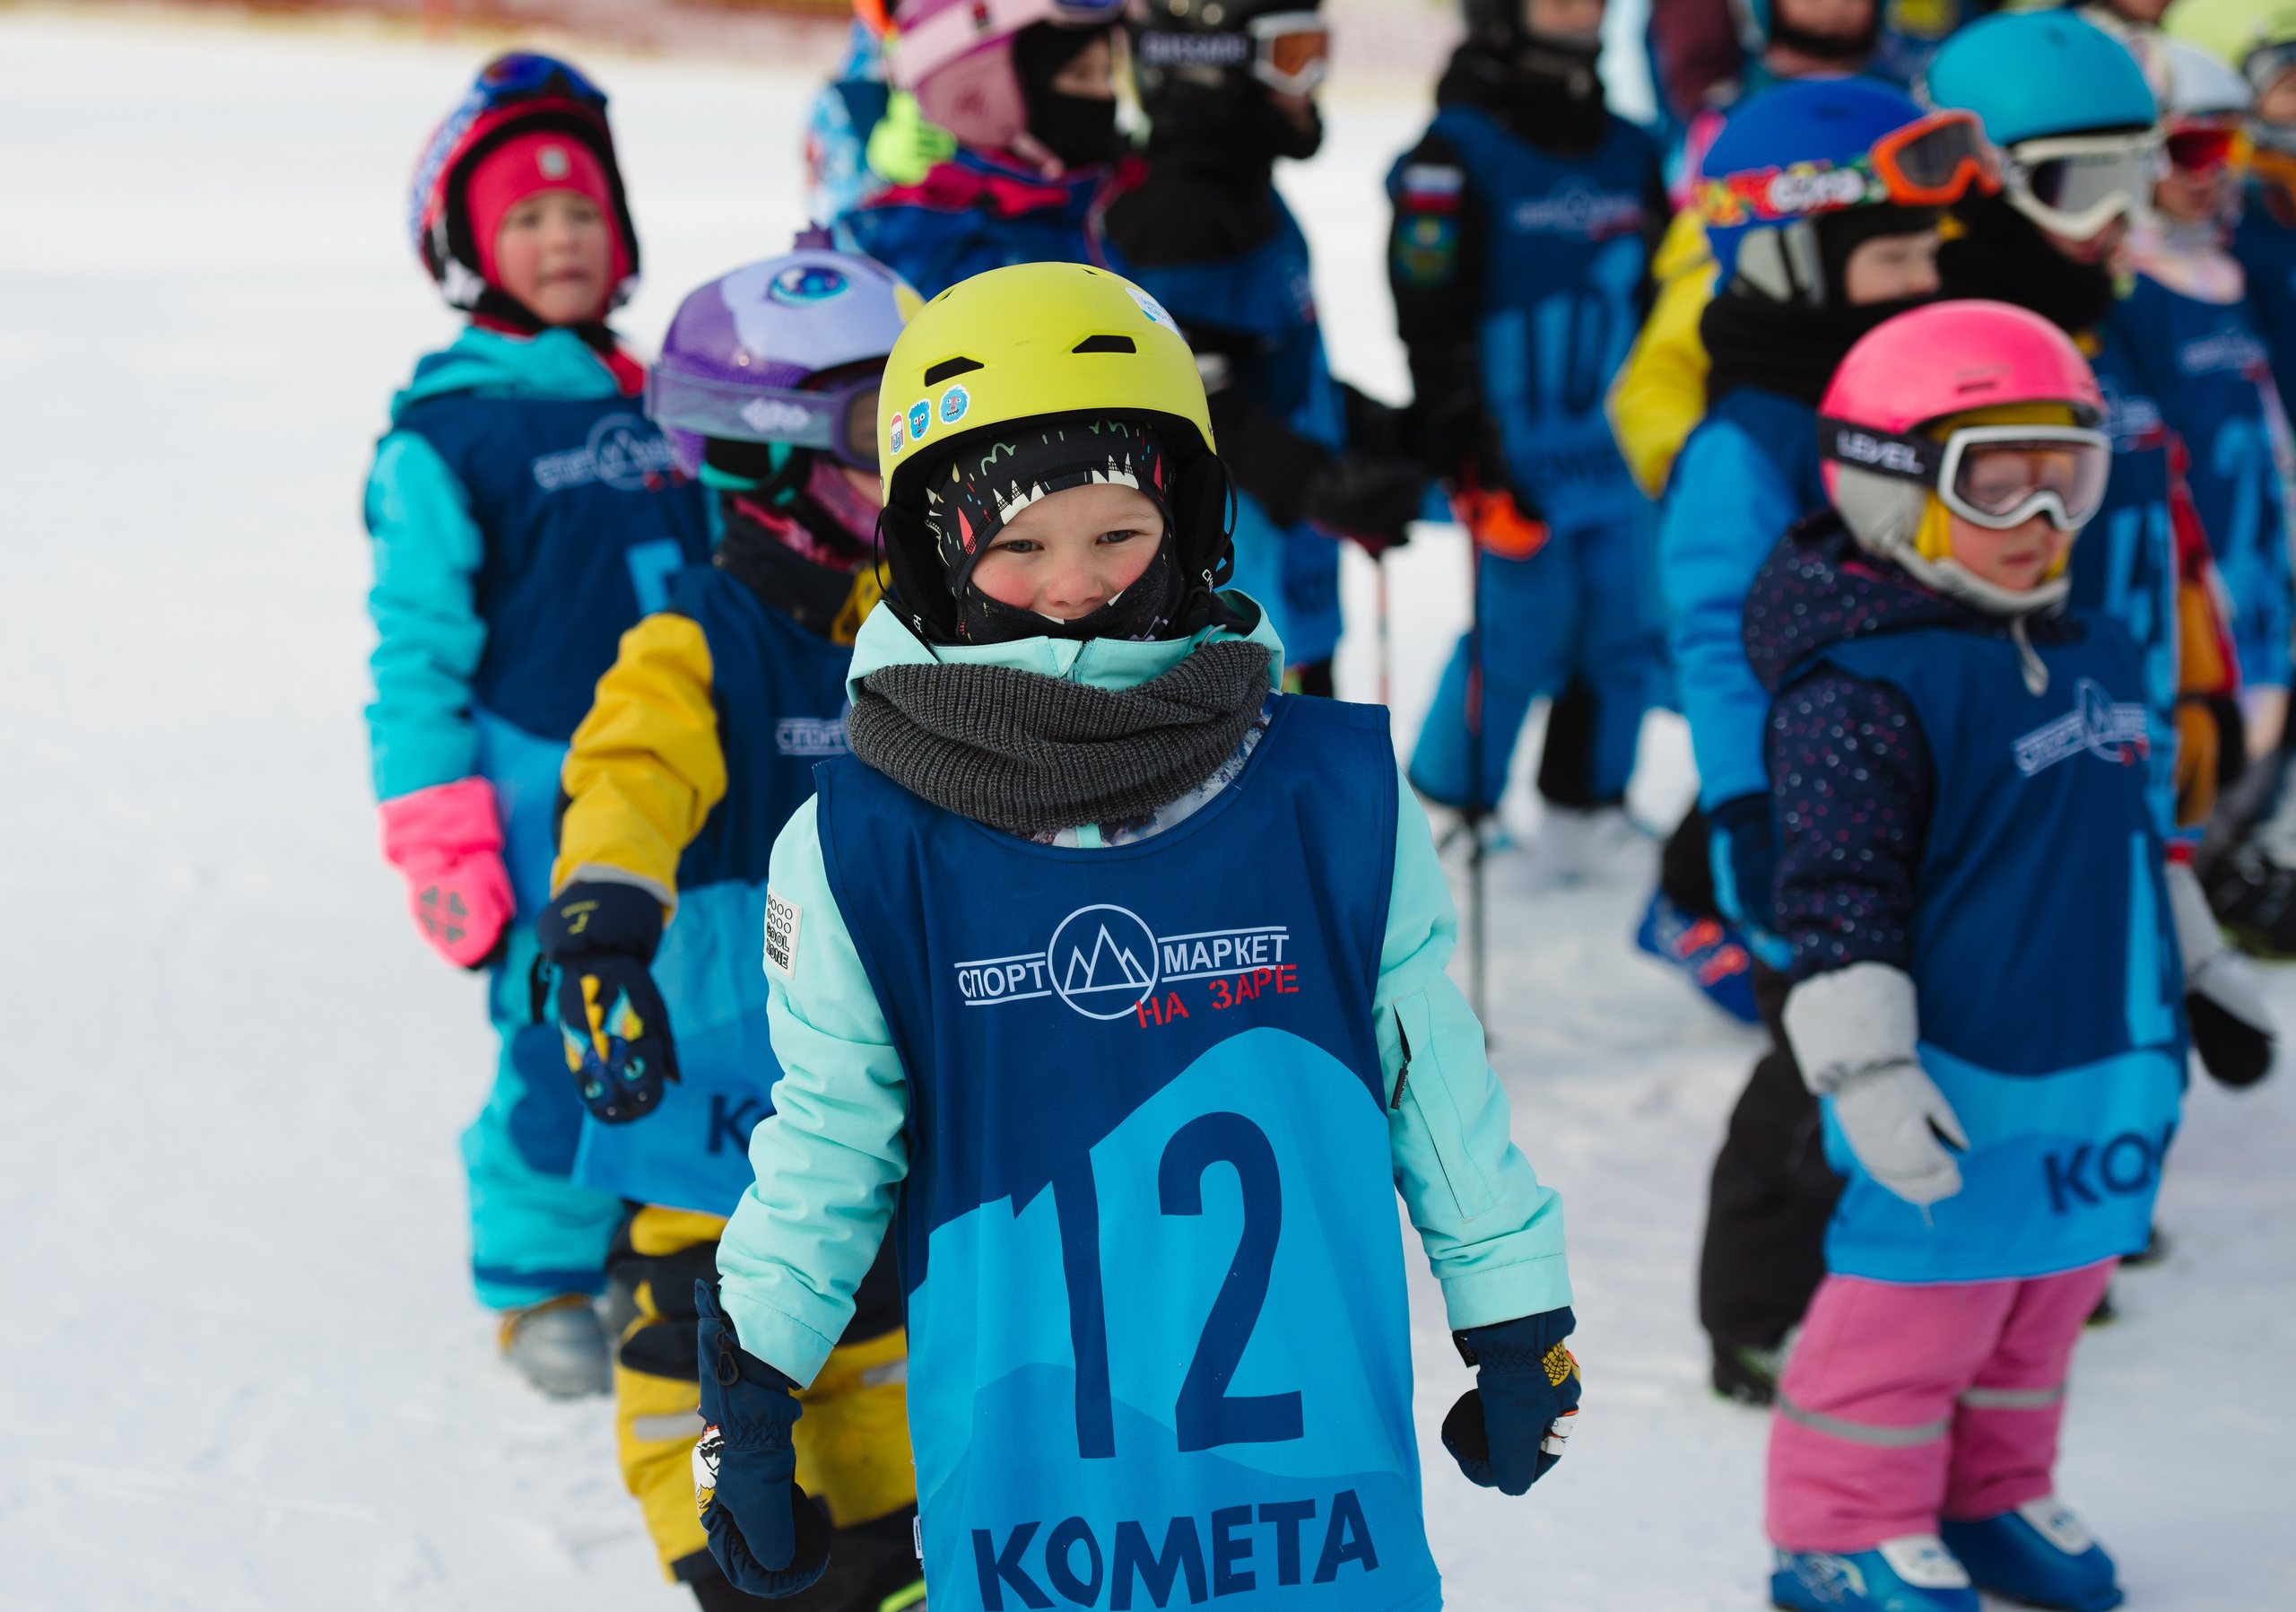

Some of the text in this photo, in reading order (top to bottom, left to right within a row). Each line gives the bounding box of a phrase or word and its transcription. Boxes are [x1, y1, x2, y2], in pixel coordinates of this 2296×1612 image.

[1837, 429, 1925, 475] LEVEL
[766, 937, 788, 970] ZONE
[767, 921, 789, 952] COOL
[958, 934, 1290, 998] СПОРТ МАРКЕТ
[1135, 963, 1299, 1029] НА ЗАРЕ
[1011, 1111, 1304, 1460] 12
[970, 1489, 1379, 1612] КОМЕТА
